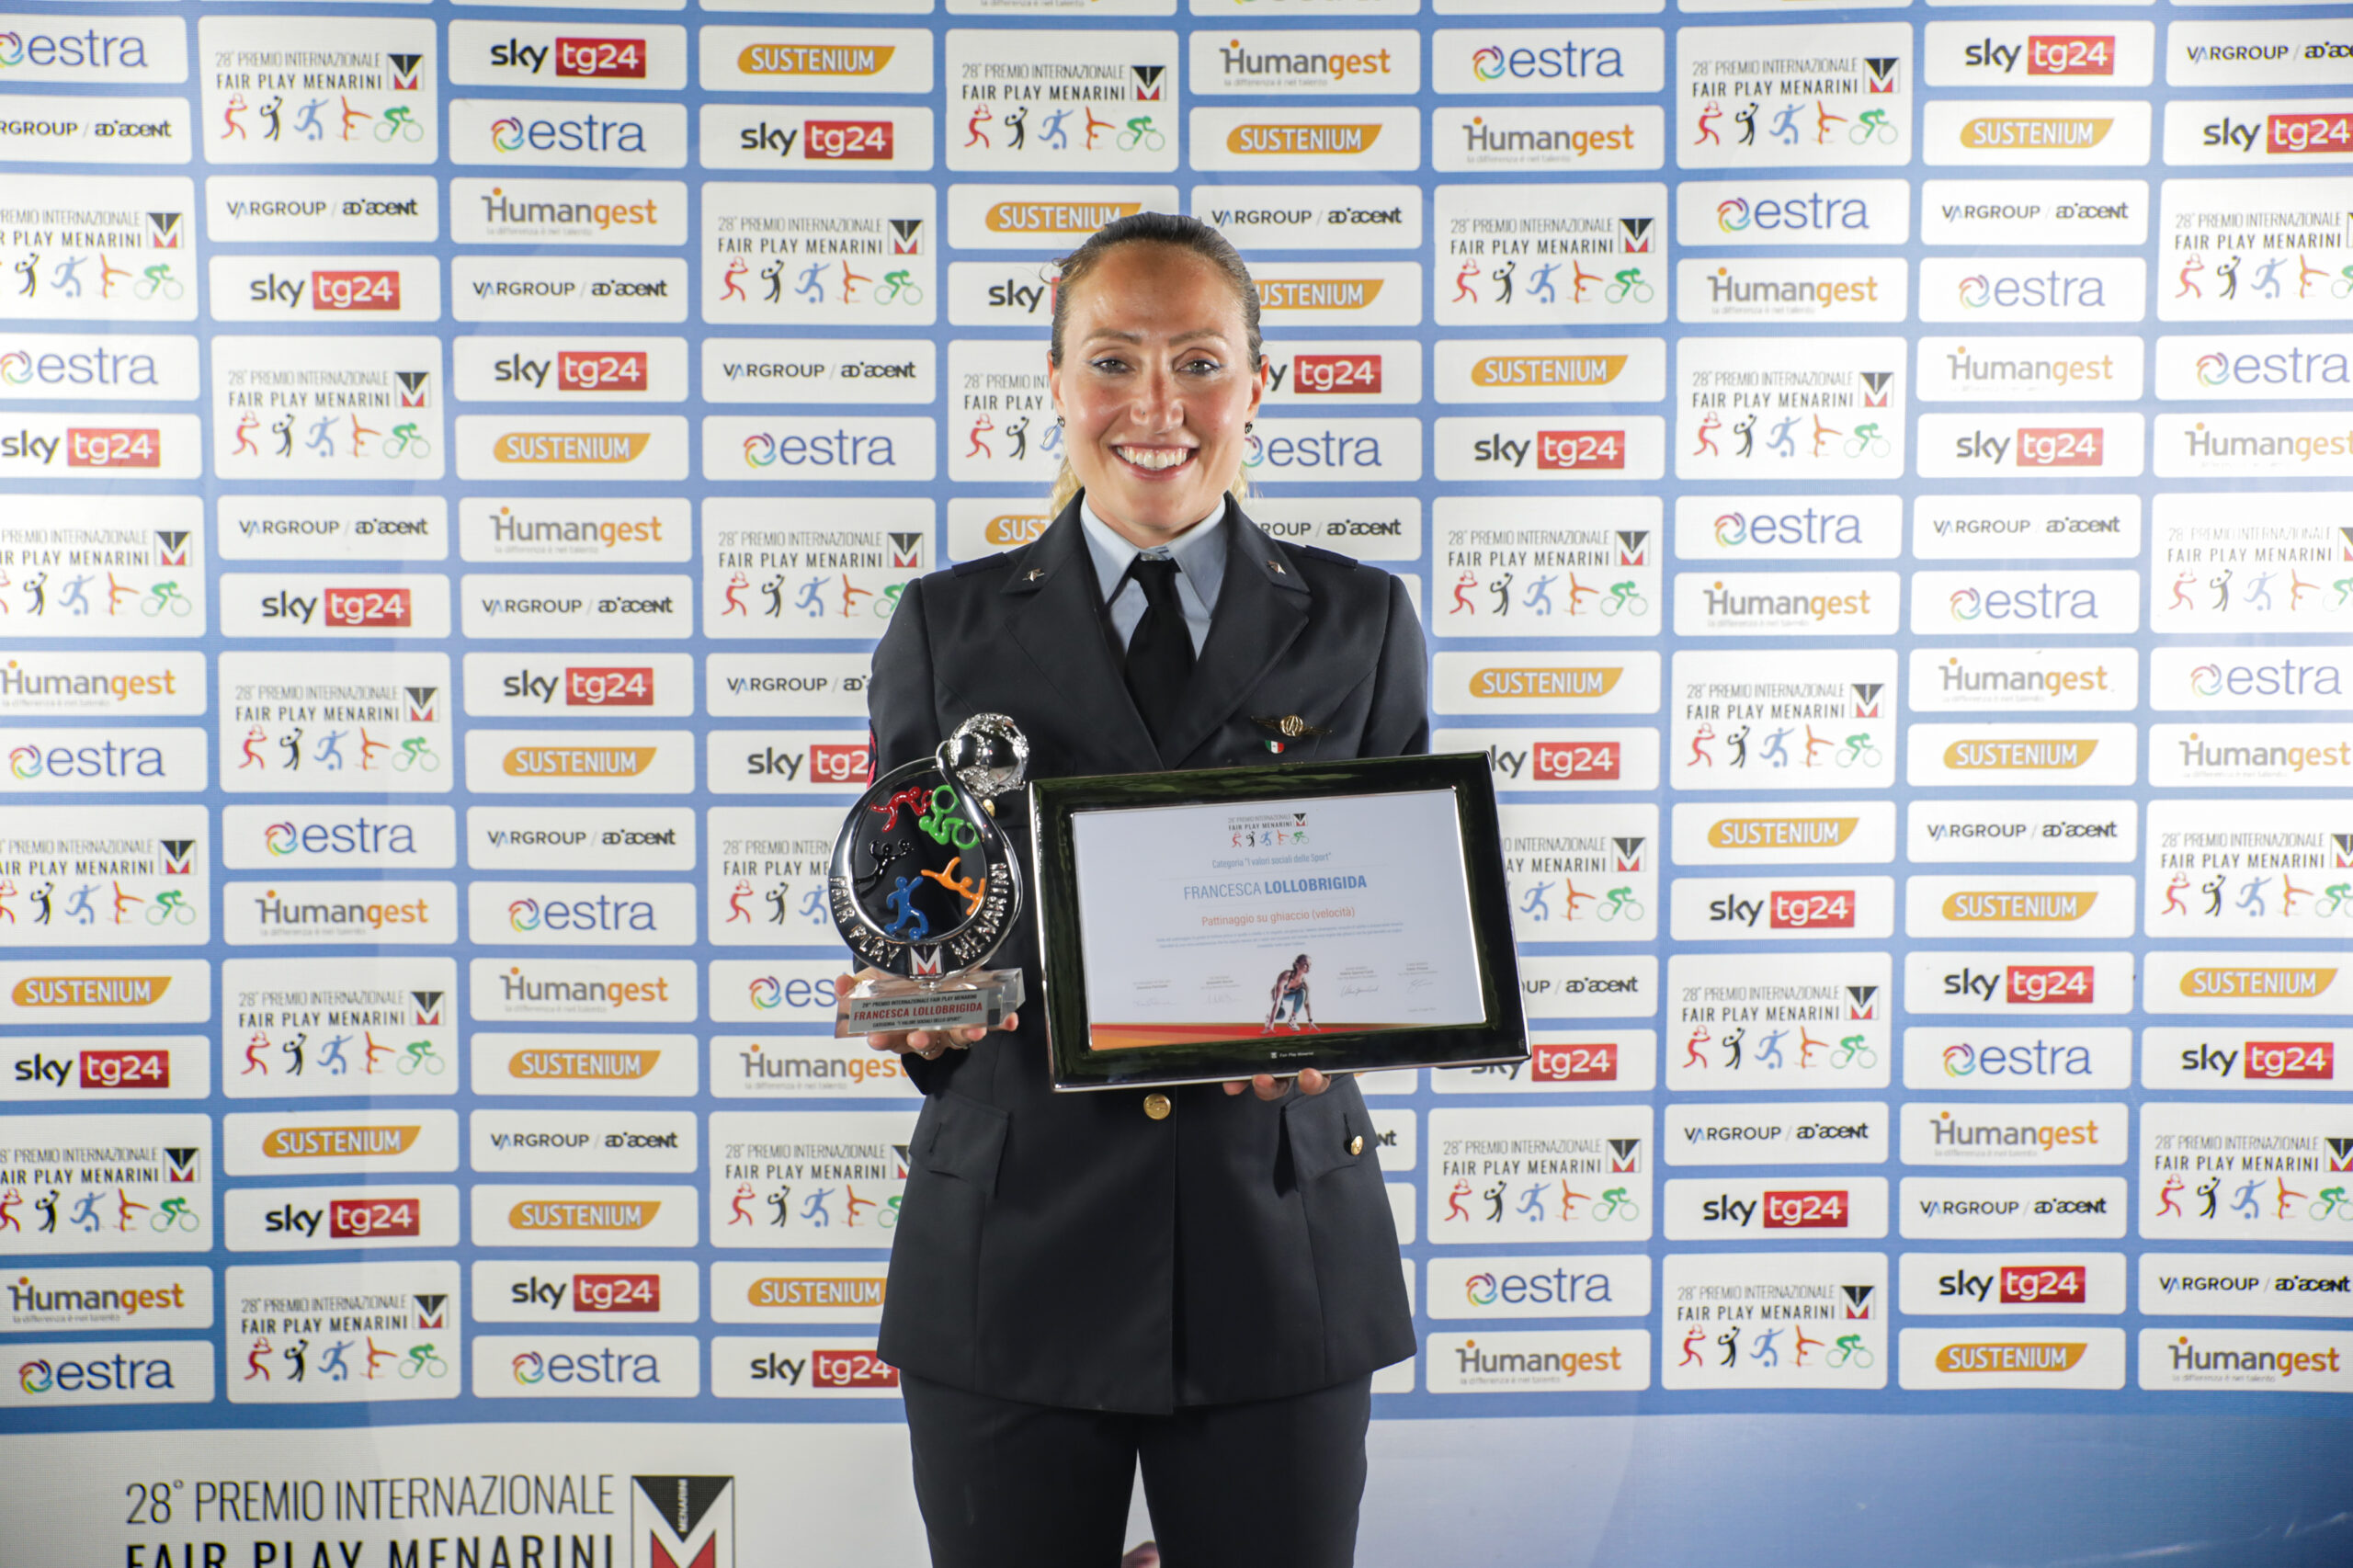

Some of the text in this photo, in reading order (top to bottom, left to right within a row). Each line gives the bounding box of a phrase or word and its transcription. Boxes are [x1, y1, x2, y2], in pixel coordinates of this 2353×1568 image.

[28, 29, 148, 67] estra
[490, 37, 639, 74] sky tg24
[750, 47, 876, 73] SUSTENIUM
[1219, 39, 1391, 82] Humangest
[1509, 40, 1624, 78] estra
[1965, 37, 2108, 74] sky tg24
[984, 63, 1029, 79] PREMIO
[1031, 63, 1126, 80] INTERNAZIONALE
[1716, 60, 1760, 75] PREMIO
[1763, 57, 1859, 74] INTERNAZIONALE
[962, 84, 1126, 101] FAIR PLAY MENARINI
[1693, 78, 1859, 97] FAIR PLAY MENARINI
[528, 114, 646, 153] estra
[740, 121, 886, 157] sky tg24
[1239, 127, 1363, 152] SUSTENIUM
[1461, 116, 1634, 158] Humangest
[1972, 121, 2095, 145] SUSTENIUM
[481, 187, 658, 232] Humangest
[1754, 192, 1870, 230] estra
[250, 273, 393, 308] sky tg24
[1706, 267, 1878, 309] Humangest
[37, 347, 158, 384] estra
[494, 353, 641, 389] sky tg24
[1483, 358, 1608, 383] SUSTENIUM
[1, 429, 153, 464] sky tg24
[780, 429, 896, 466] estra
[1473, 433, 1619, 468] sky tg24
[489, 506, 663, 549] Humangest
[1750, 508, 1862, 544] estra
[261, 590, 405, 625] sky tg24
[0, 660, 177, 701] Humangest
[503, 669, 647, 704] sky tg24
[1938, 657, 2108, 697] Humangest
[47, 741, 165, 777] estra
[515, 749, 638, 774] SUSTENIUM
[1954, 743, 2078, 766] SUSTENIUM
[302, 817, 416, 853] estra
[1262, 821, 1292, 829] MENARINI
[1719, 821, 1840, 845] SUSTENIUM
[1212, 858, 1245, 869] Categoria
[1251, 856, 1270, 866] valori
[1271, 854, 1292, 865] sociali
[1184, 875, 1368, 901] FRANCESCA LOLLOBRIGIDA
[255, 889, 429, 929] Humangest
[544, 894, 657, 930] estra
[829, 862, 1010, 969] FAIR PLAY MENARINI
[1201, 906, 1356, 926] Pattinaggio su ghiaccio (velocità)
[1709, 893, 1848, 927] sky tg24
[25, 979, 153, 1004] SUSTENIUM
[499, 966, 669, 1008] Humangest
[1943, 967, 2086, 1002] sky tg24
[2191, 970, 2317, 994] SUSTENIUM
[854, 1002, 983, 1021] FRANCESCA LOLLOBRIGIDA
[872, 999, 891, 1007] PREMIO
[891, 996, 929, 1006] INTERNAZIONALE
[930, 995, 941, 1004] FAIR
[941, 994, 954, 1003] PLAY
[954, 993, 978, 1002] MENARINI
[14, 1052, 163, 1088] sky tg24
[520, 1052, 642, 1076] SUSTENIUM
[1980, 1040, 2092, 1075] estra
[2181, 1043, 2325, 1077] sky tg24
[276, 1129, 403, 1154] SUSTENIUM
[1465, 1140, 1507, 1155] PREMIO
[1510, 1139, 1601, 1154] INTERNAZIONALE
[1929, 1110, 2098, 1152] Humangest
[1443, 1158, 1601, 1176] FAIR PLAY MENARINI
[265, 1203, 413, 1238] sky tg24
[1702, 1193, 1842, 1228] sky tg24
[6, 1276, 186, 1316] Humangest
[511, 1276, 653, 1311] sky tg24
[1501, 1267, 1612, 1303] estra
[1938, 1268, 2078, 1302] sky tg24
[264, 1297, 309, 1313] PREMIO
[312, 1295, 408, 1312] INTERNAZIONALE
[241, 1314, 408, 1335] FAIR PLAY MENARINI
[55, 1353, 175, 1392] estra
[548, 1347, 661, 1383] estra
[1455, 1338, 1621, 1378] Humangest
[1947, 1346, 2068, 1369] SUSTENIUM
[2167, 1336, 2341, 1378] Humangest
[125, 1474, 615, 1525] 28° PREMIO INTERNAZIONALE
